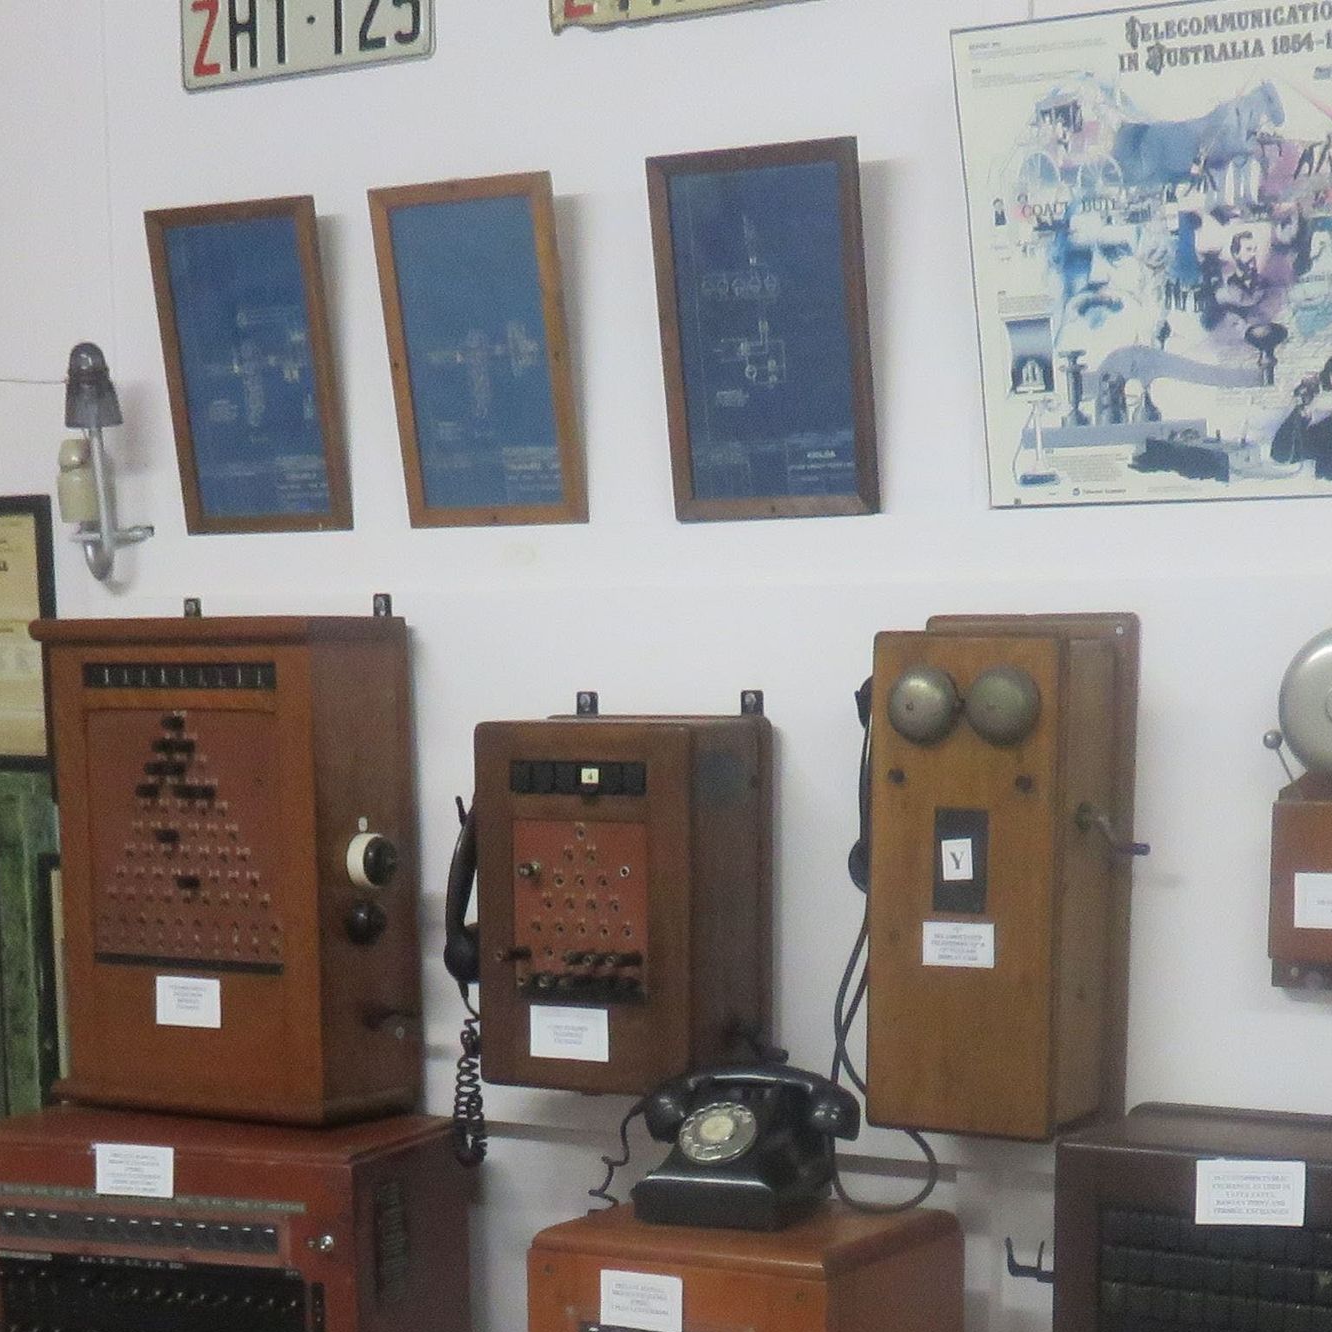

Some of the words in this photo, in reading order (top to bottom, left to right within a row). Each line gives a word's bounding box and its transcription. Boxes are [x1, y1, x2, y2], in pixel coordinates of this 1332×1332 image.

[1119, 53, 1139, 73] IN
[1146, 39, 1265, 75] AUSTRALIA
[950, 851, 964, 870] Y
